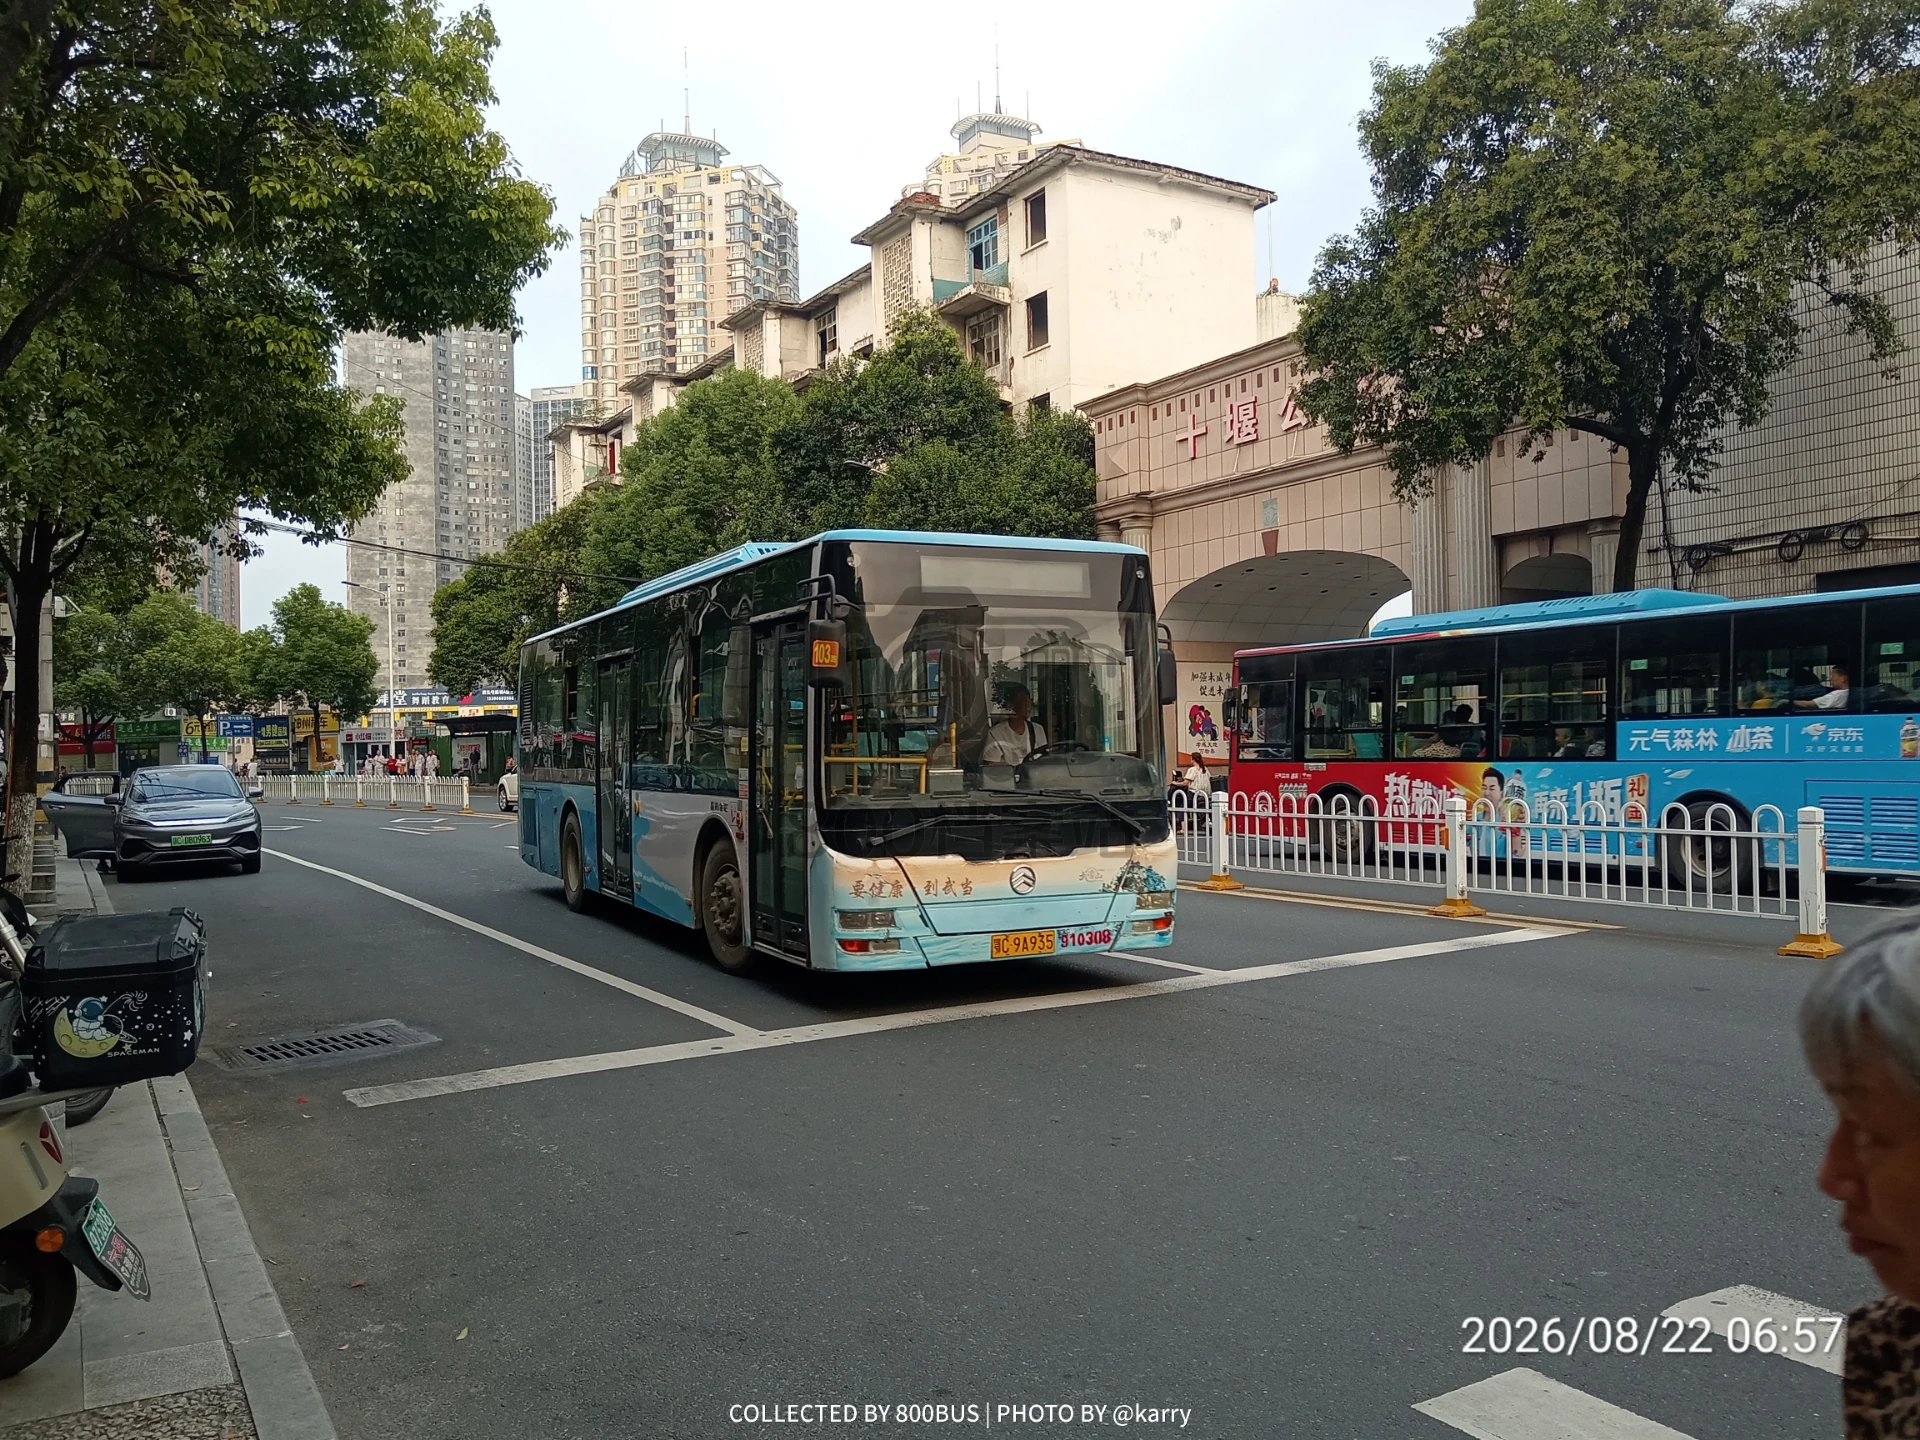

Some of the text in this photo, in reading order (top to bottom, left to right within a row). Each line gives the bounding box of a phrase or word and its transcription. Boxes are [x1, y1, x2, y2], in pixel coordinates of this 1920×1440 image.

[220, 722, 230, 735] P
[1629, 724, 1864, 753] 元气森林 冰茶 京东
[849, 876, 973, 899] 要健康 到武当
[1060, 928, 1112, 948] 910308
[107, 1047, 160, 1058] SPACEMAN
